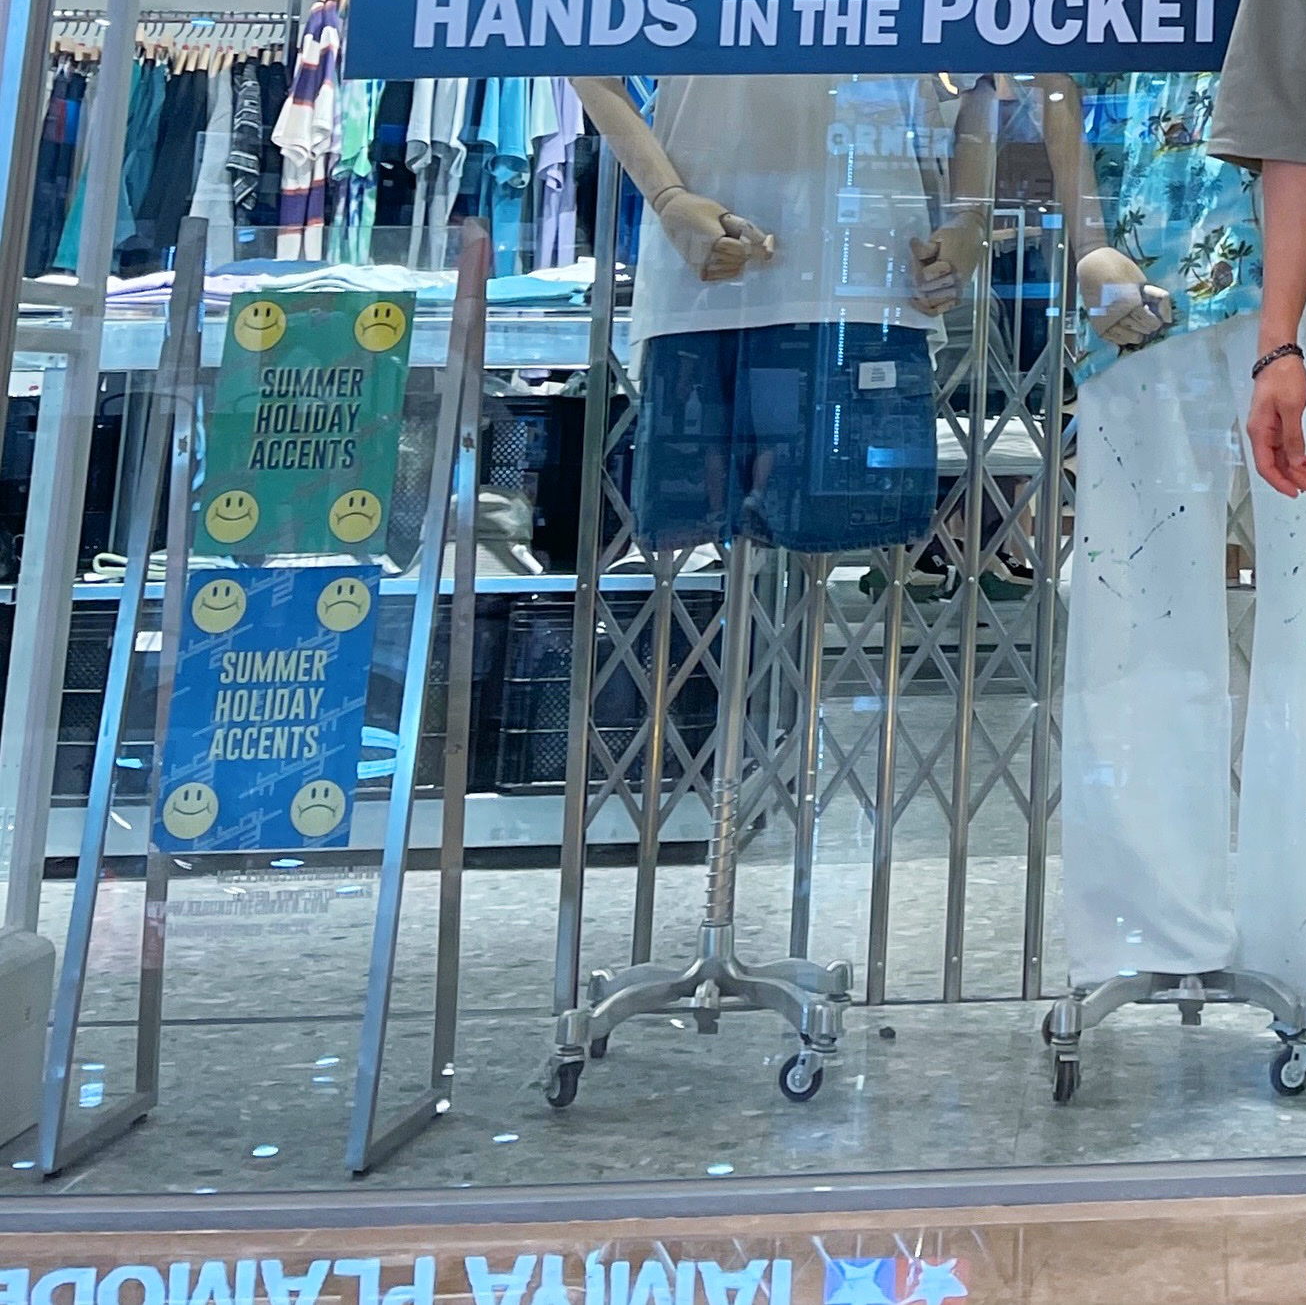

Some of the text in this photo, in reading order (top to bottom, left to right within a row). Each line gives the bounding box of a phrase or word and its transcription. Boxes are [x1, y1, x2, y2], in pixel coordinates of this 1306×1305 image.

[260, 365, 364, 399] SUMMER
[254, 400, 361, 435] HOLIDAY
[248, 437, 356, 471] ACCENTS
[220, 649, 328, 684] SUMMER
[214, 687, 325, 723] HOLIDAY
[208, 725, 320, 761] ACCENTS
